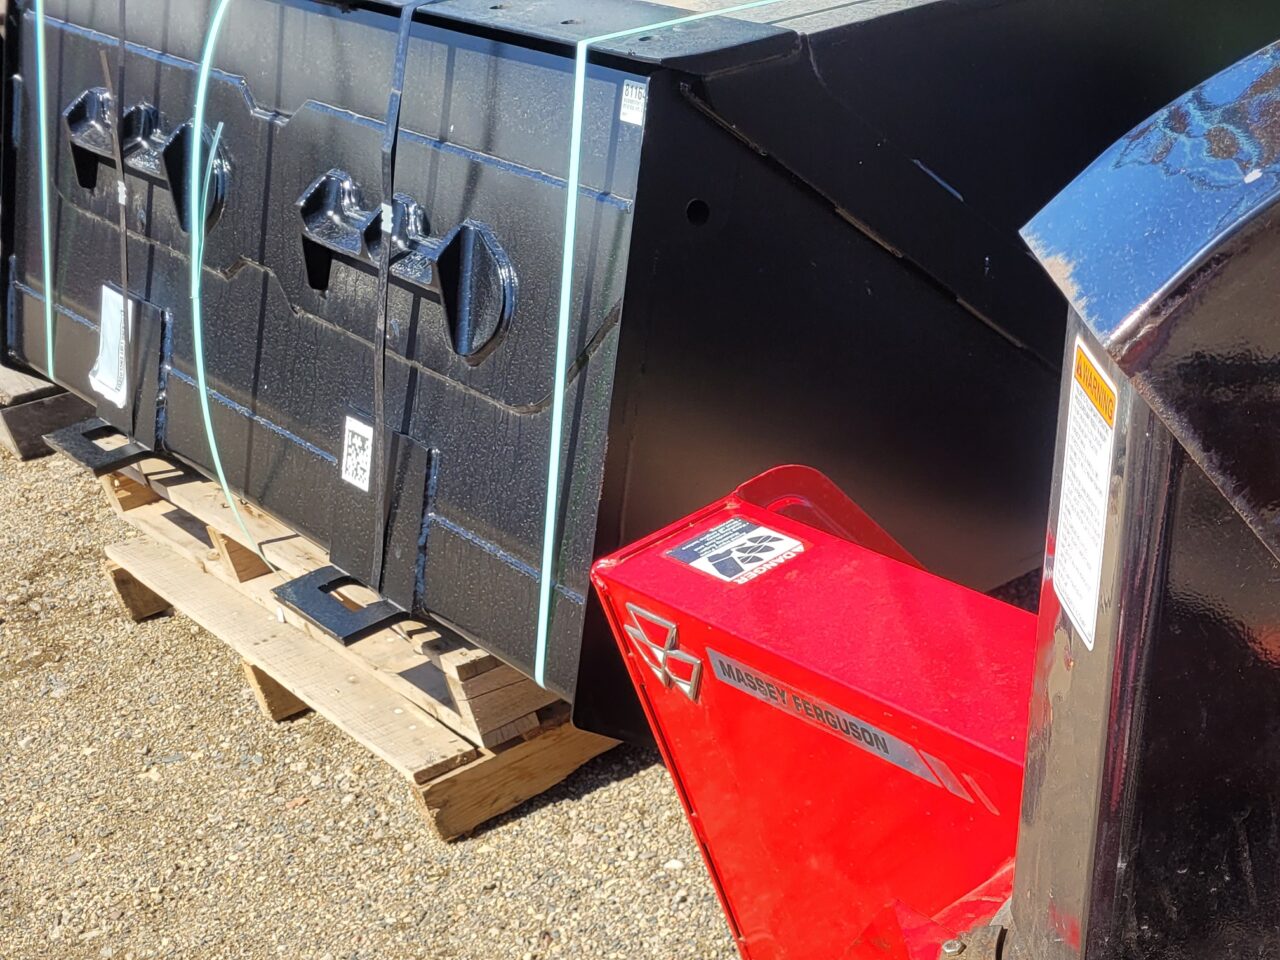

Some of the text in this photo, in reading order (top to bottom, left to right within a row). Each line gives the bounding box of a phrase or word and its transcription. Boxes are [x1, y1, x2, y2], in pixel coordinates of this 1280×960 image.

[1082, 362, 1113, 420] WARNING
[733, 551, 798, 584] DANGER
[719, 659, 890, 754] MASSEY FERGUSON
